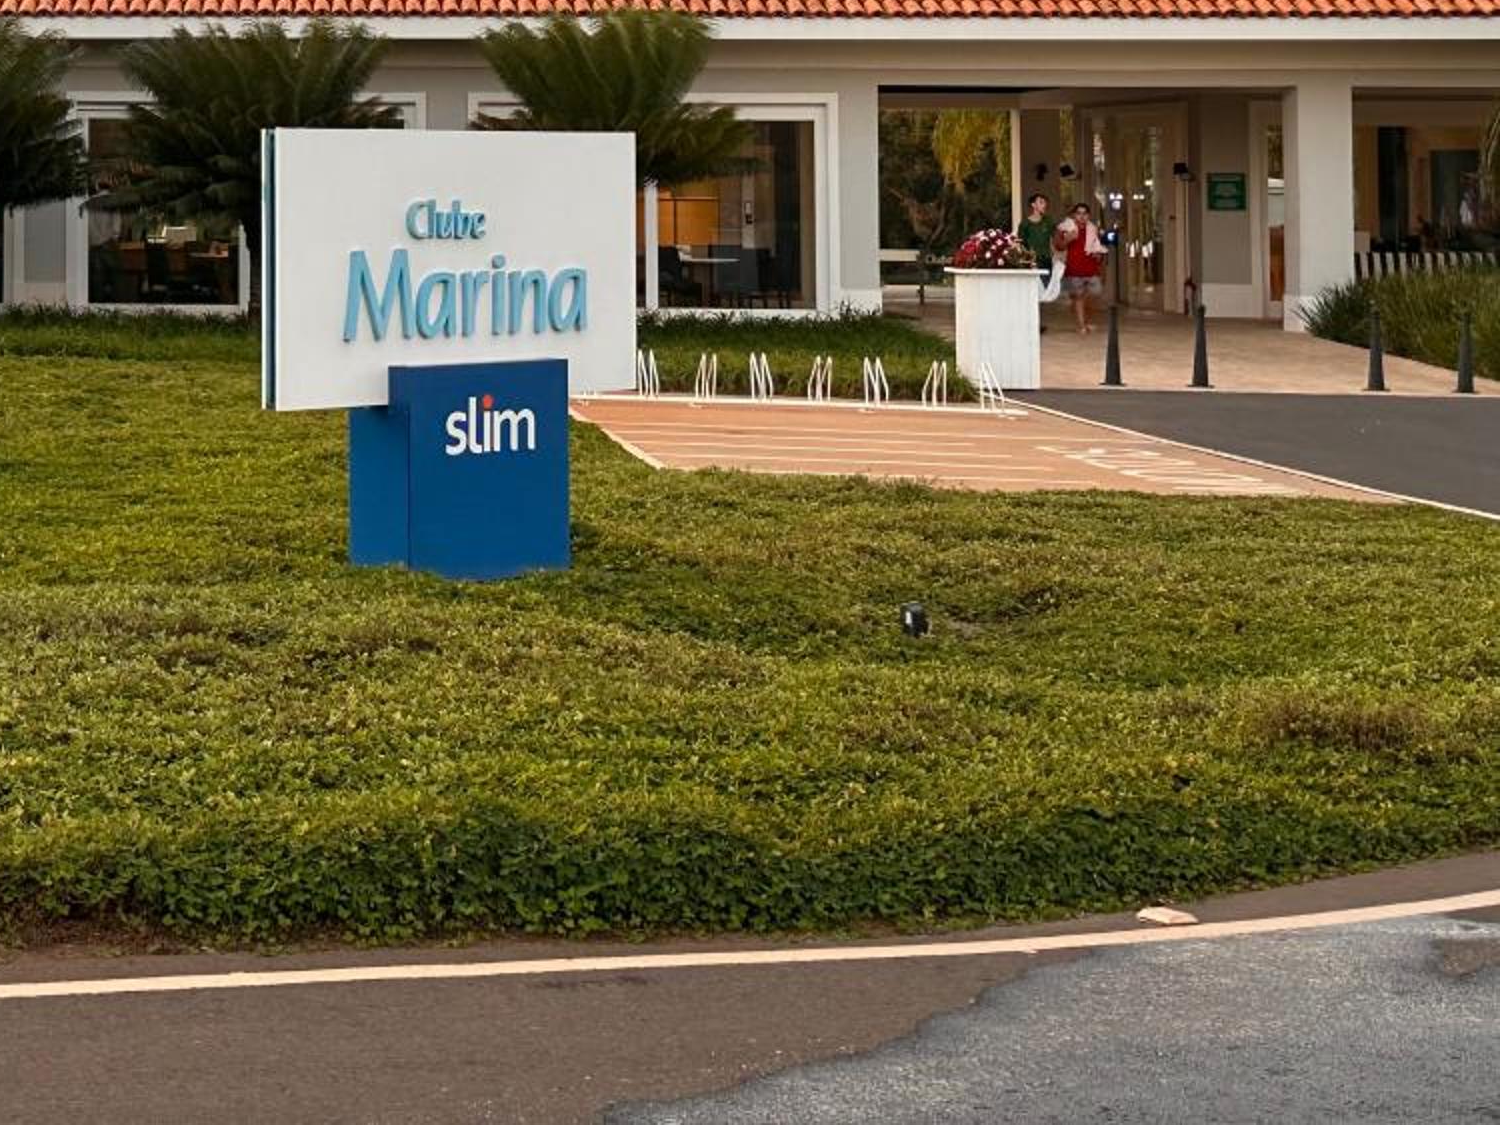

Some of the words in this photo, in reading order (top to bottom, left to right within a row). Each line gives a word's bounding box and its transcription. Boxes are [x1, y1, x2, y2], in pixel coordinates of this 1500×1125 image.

[406, 199, 486, 240] Clube
[343, 249, 588, 342] Marina
[445, 394, 536, 455] slim
